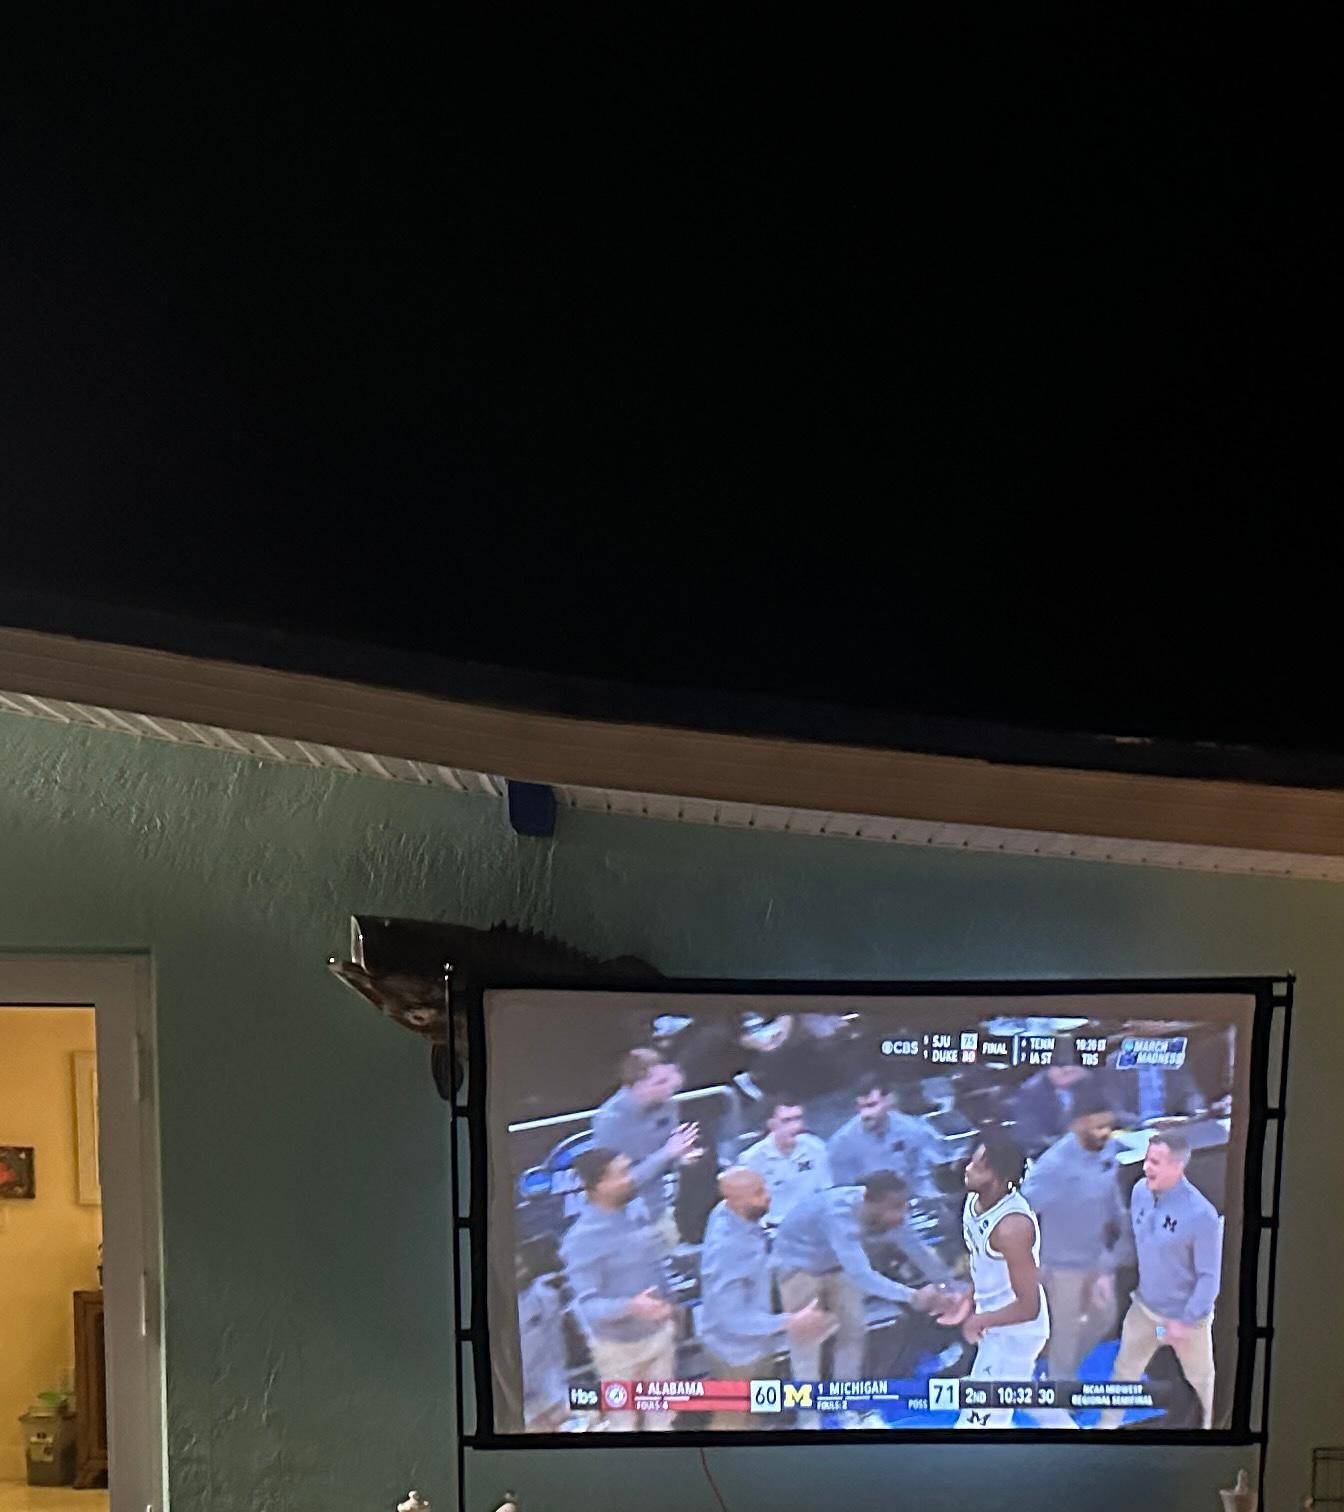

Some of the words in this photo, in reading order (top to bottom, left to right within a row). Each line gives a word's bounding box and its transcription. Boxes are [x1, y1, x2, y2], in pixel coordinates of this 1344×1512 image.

[932, 1034, 951, 1048] SJU
[982, 1042, 1007, 1055] FINAL
[932, 1050, 958, 1063] DUKE
[648, 1382, 704, 1395] ALABAMA
[756, 1386, 776, 1405] 60
[783, 1384, 812, 1407] M
[829, 1381, 888, 1396] MICHIGAN
[933, 1385, 954, 1405] 71
[965, 1388, 987, 1404] 2ND
[998, 1388, 1032, 1404] 10:32
[1038, 1388, 1055, 1404] 30
